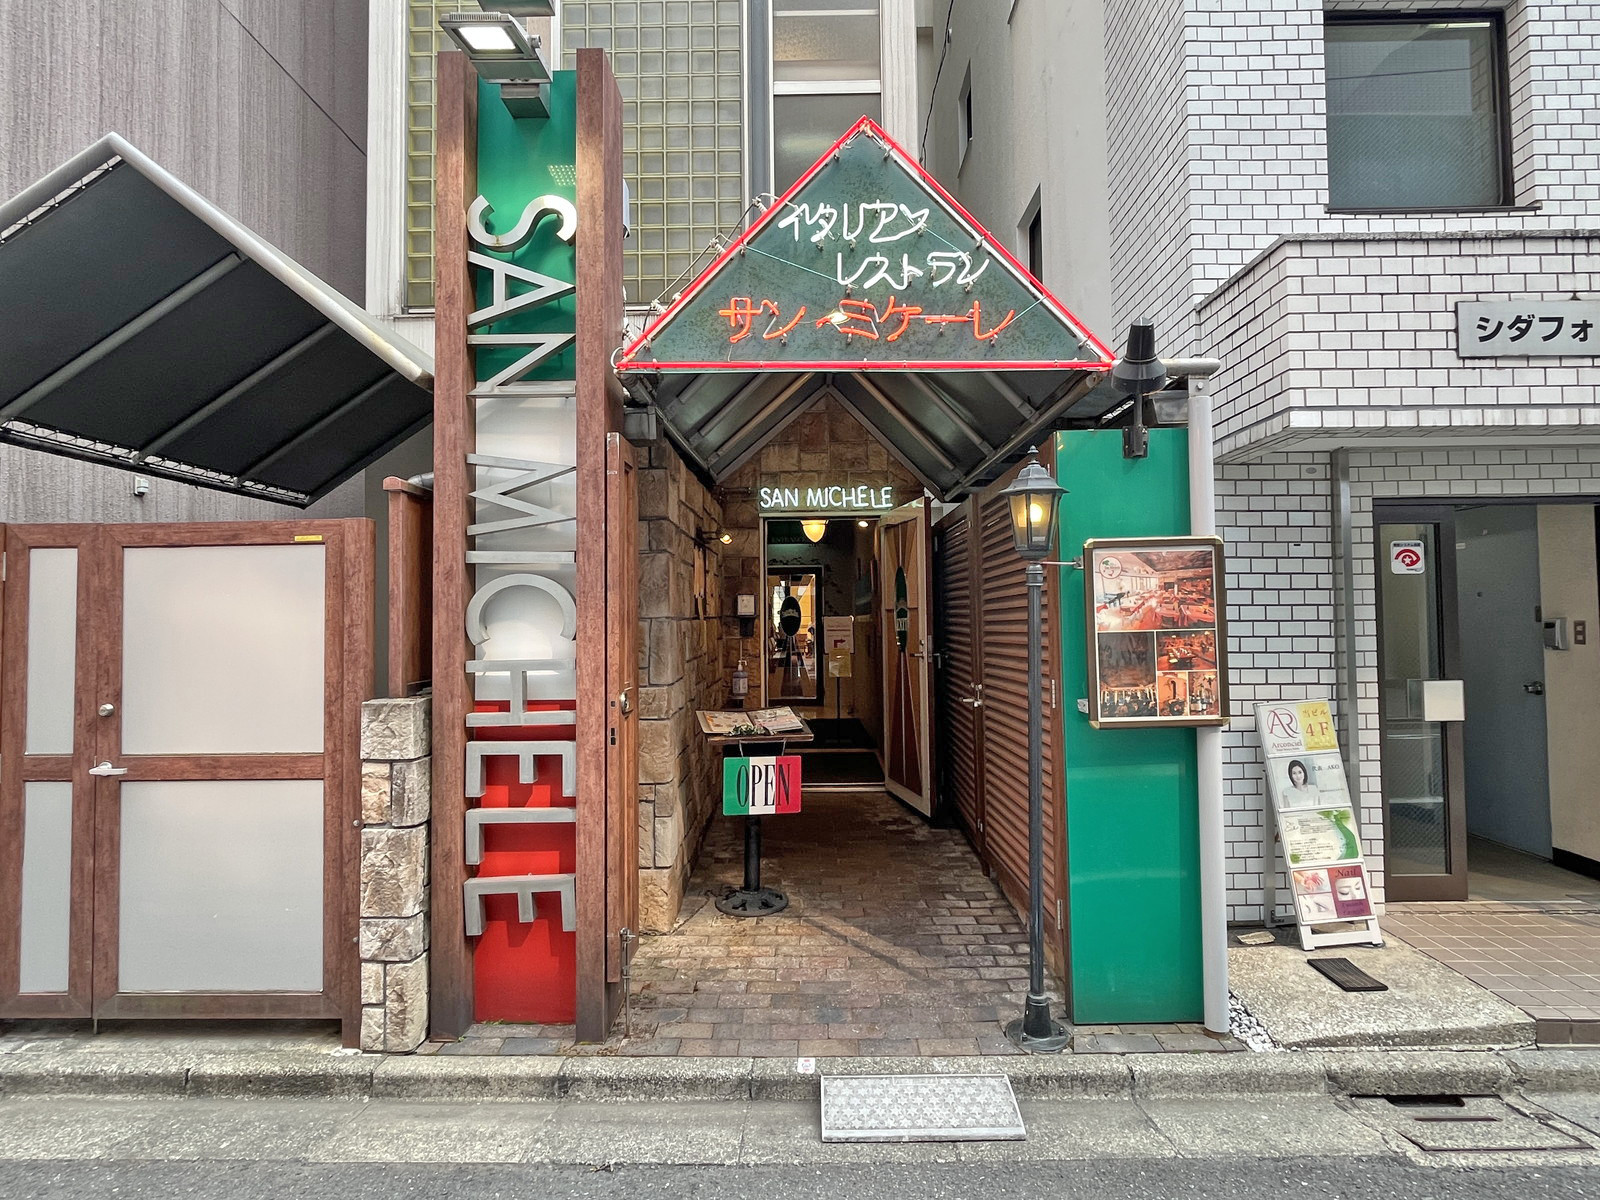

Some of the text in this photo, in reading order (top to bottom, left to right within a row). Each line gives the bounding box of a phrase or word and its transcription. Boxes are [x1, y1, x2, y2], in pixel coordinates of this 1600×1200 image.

[778, 201, 930, 243] イタリアン
[837, 251, 990, 291] レストラン
[1476, 314, 1594, 343] シダフォ
[759, 485, 894, 509] SAN MICHELE
[464, 194, 578, 937] SAN MICHELE
[736, 763, 791, 808] OPEN
